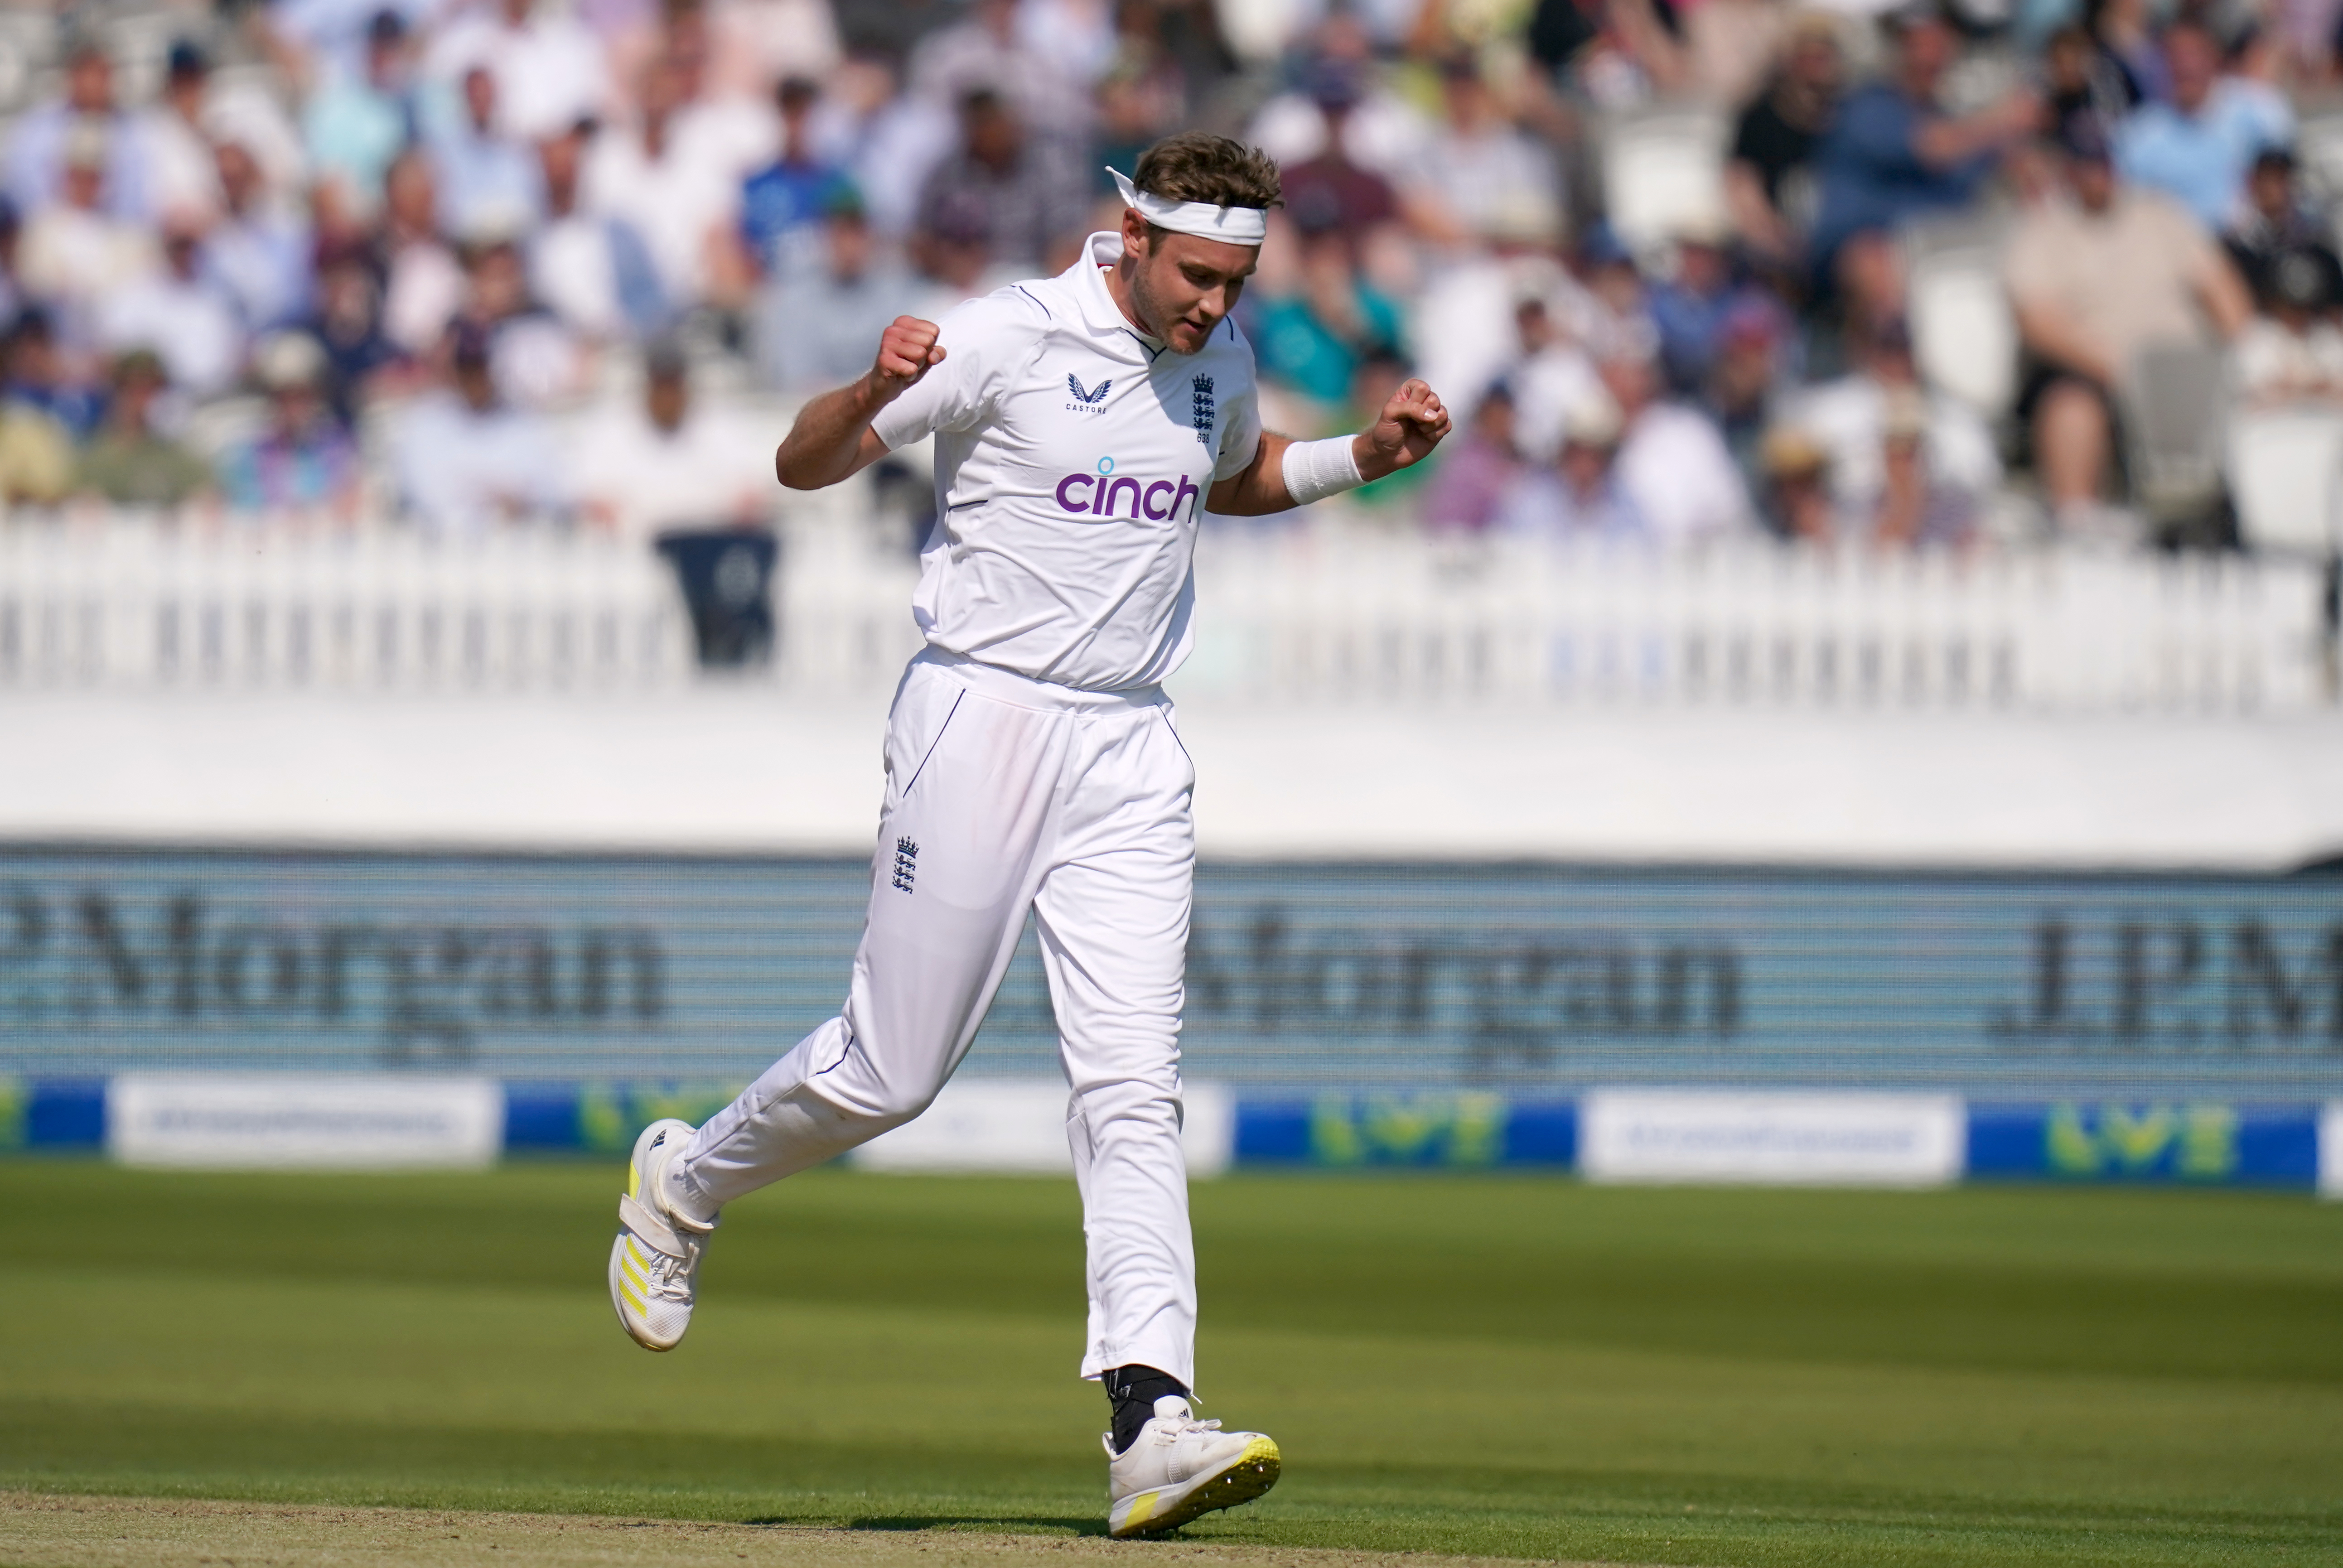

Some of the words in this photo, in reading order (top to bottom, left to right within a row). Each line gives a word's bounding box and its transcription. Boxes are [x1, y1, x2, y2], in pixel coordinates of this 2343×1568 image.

[1066, 404, 1106, 414] CASTORE
[1198, 433, 1209, 444] 638
[1056, 456, 1199, 524] cinch
